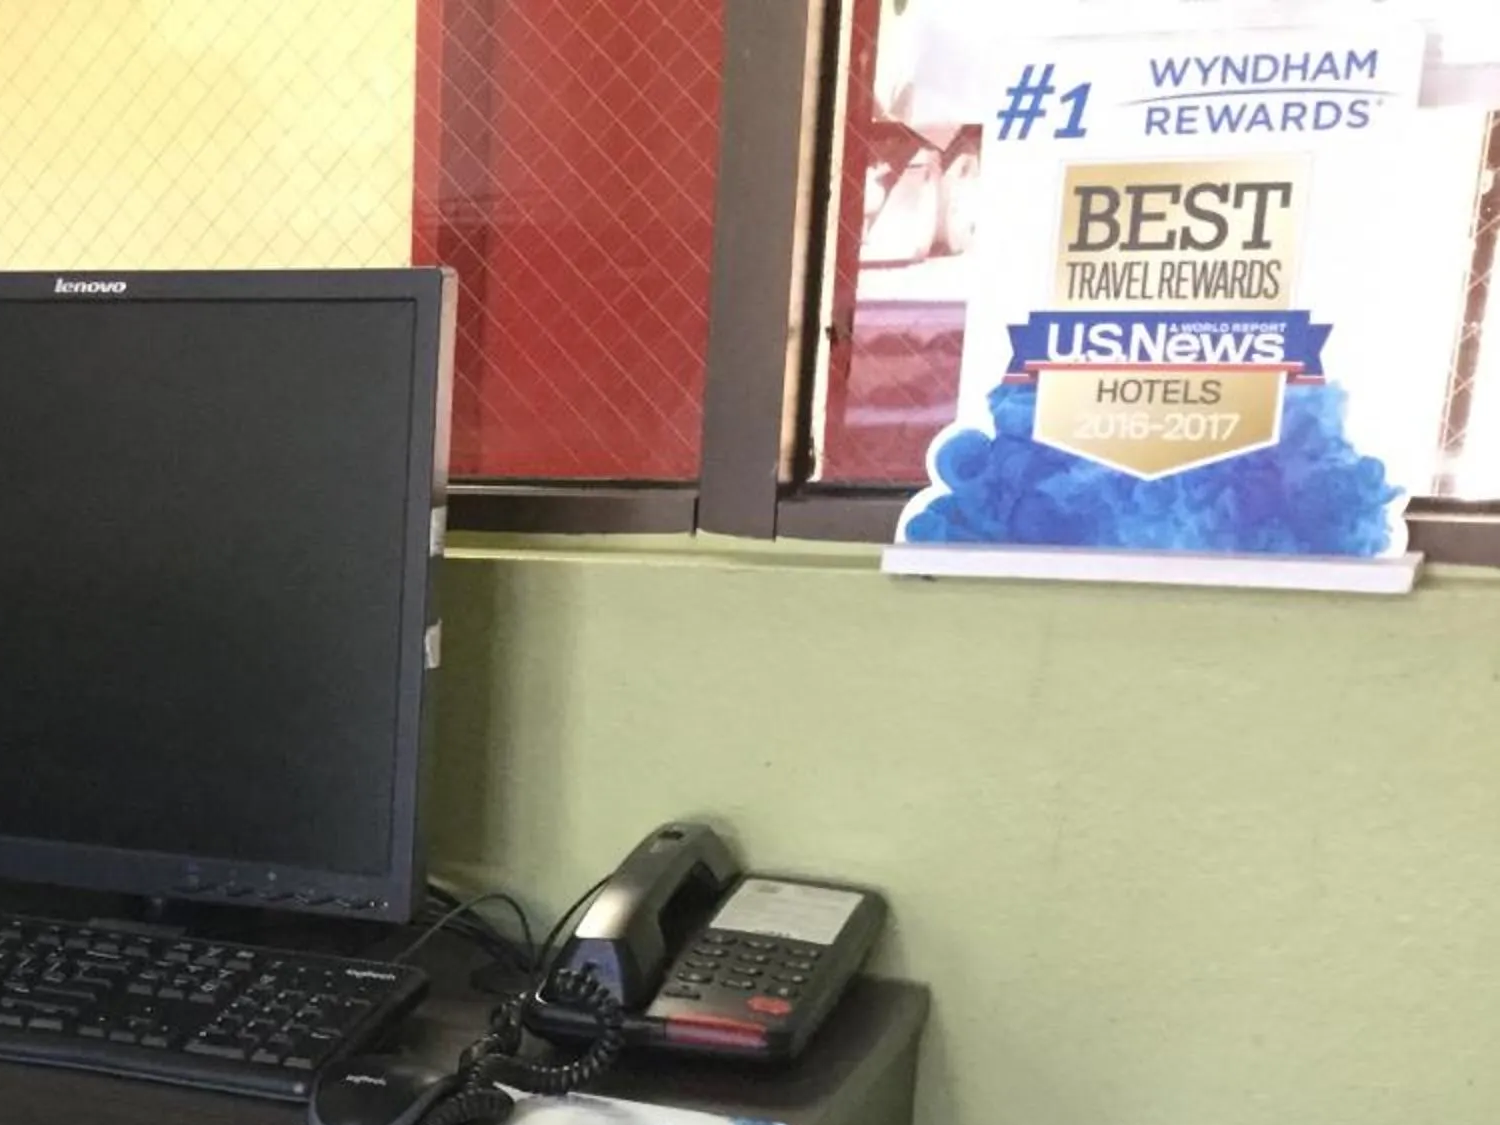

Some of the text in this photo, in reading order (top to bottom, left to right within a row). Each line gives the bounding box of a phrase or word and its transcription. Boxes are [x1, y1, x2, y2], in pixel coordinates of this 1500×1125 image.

[1150, 49, 1379, 88] WYNDHAM
[997, 63, 1095, 141] #1
[1144, 99, 1371, 136] REWARDS
[1067, 181, 1293, 253] BEST
[53, 277, 128, 293] lenovo
[1066, 259, 1283, 301] TRAVEL REWARDS
[1181, 323, 1230, 333] WORLD
[1231, 322, 1288, 333] REPORT
[1096, 378, 1222, 405] HOTELS
[1073, 412, 1242, 441] 2016-2017
